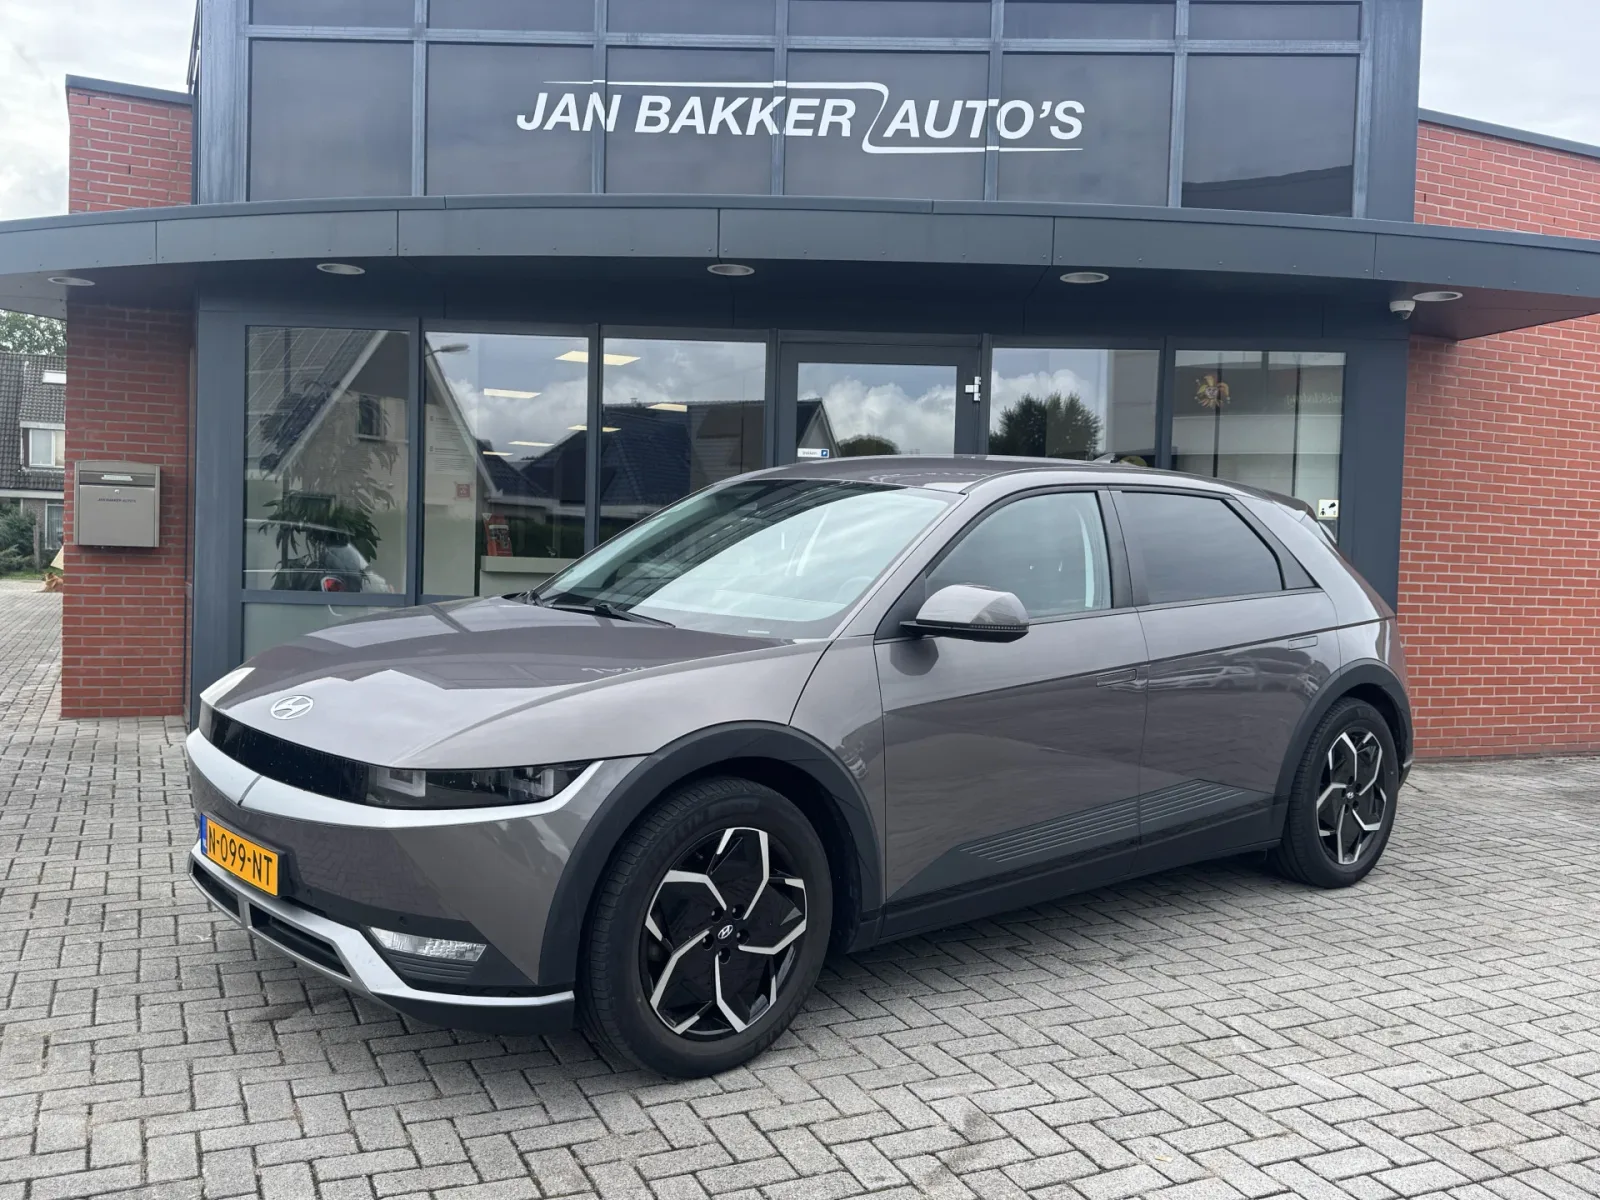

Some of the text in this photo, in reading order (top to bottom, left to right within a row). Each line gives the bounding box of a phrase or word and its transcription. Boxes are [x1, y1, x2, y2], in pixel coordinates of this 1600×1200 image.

[516, 92, 1084, 140] JAN BAKKER AUTO'S
[208, 825, 273, 886] N-099-NT
